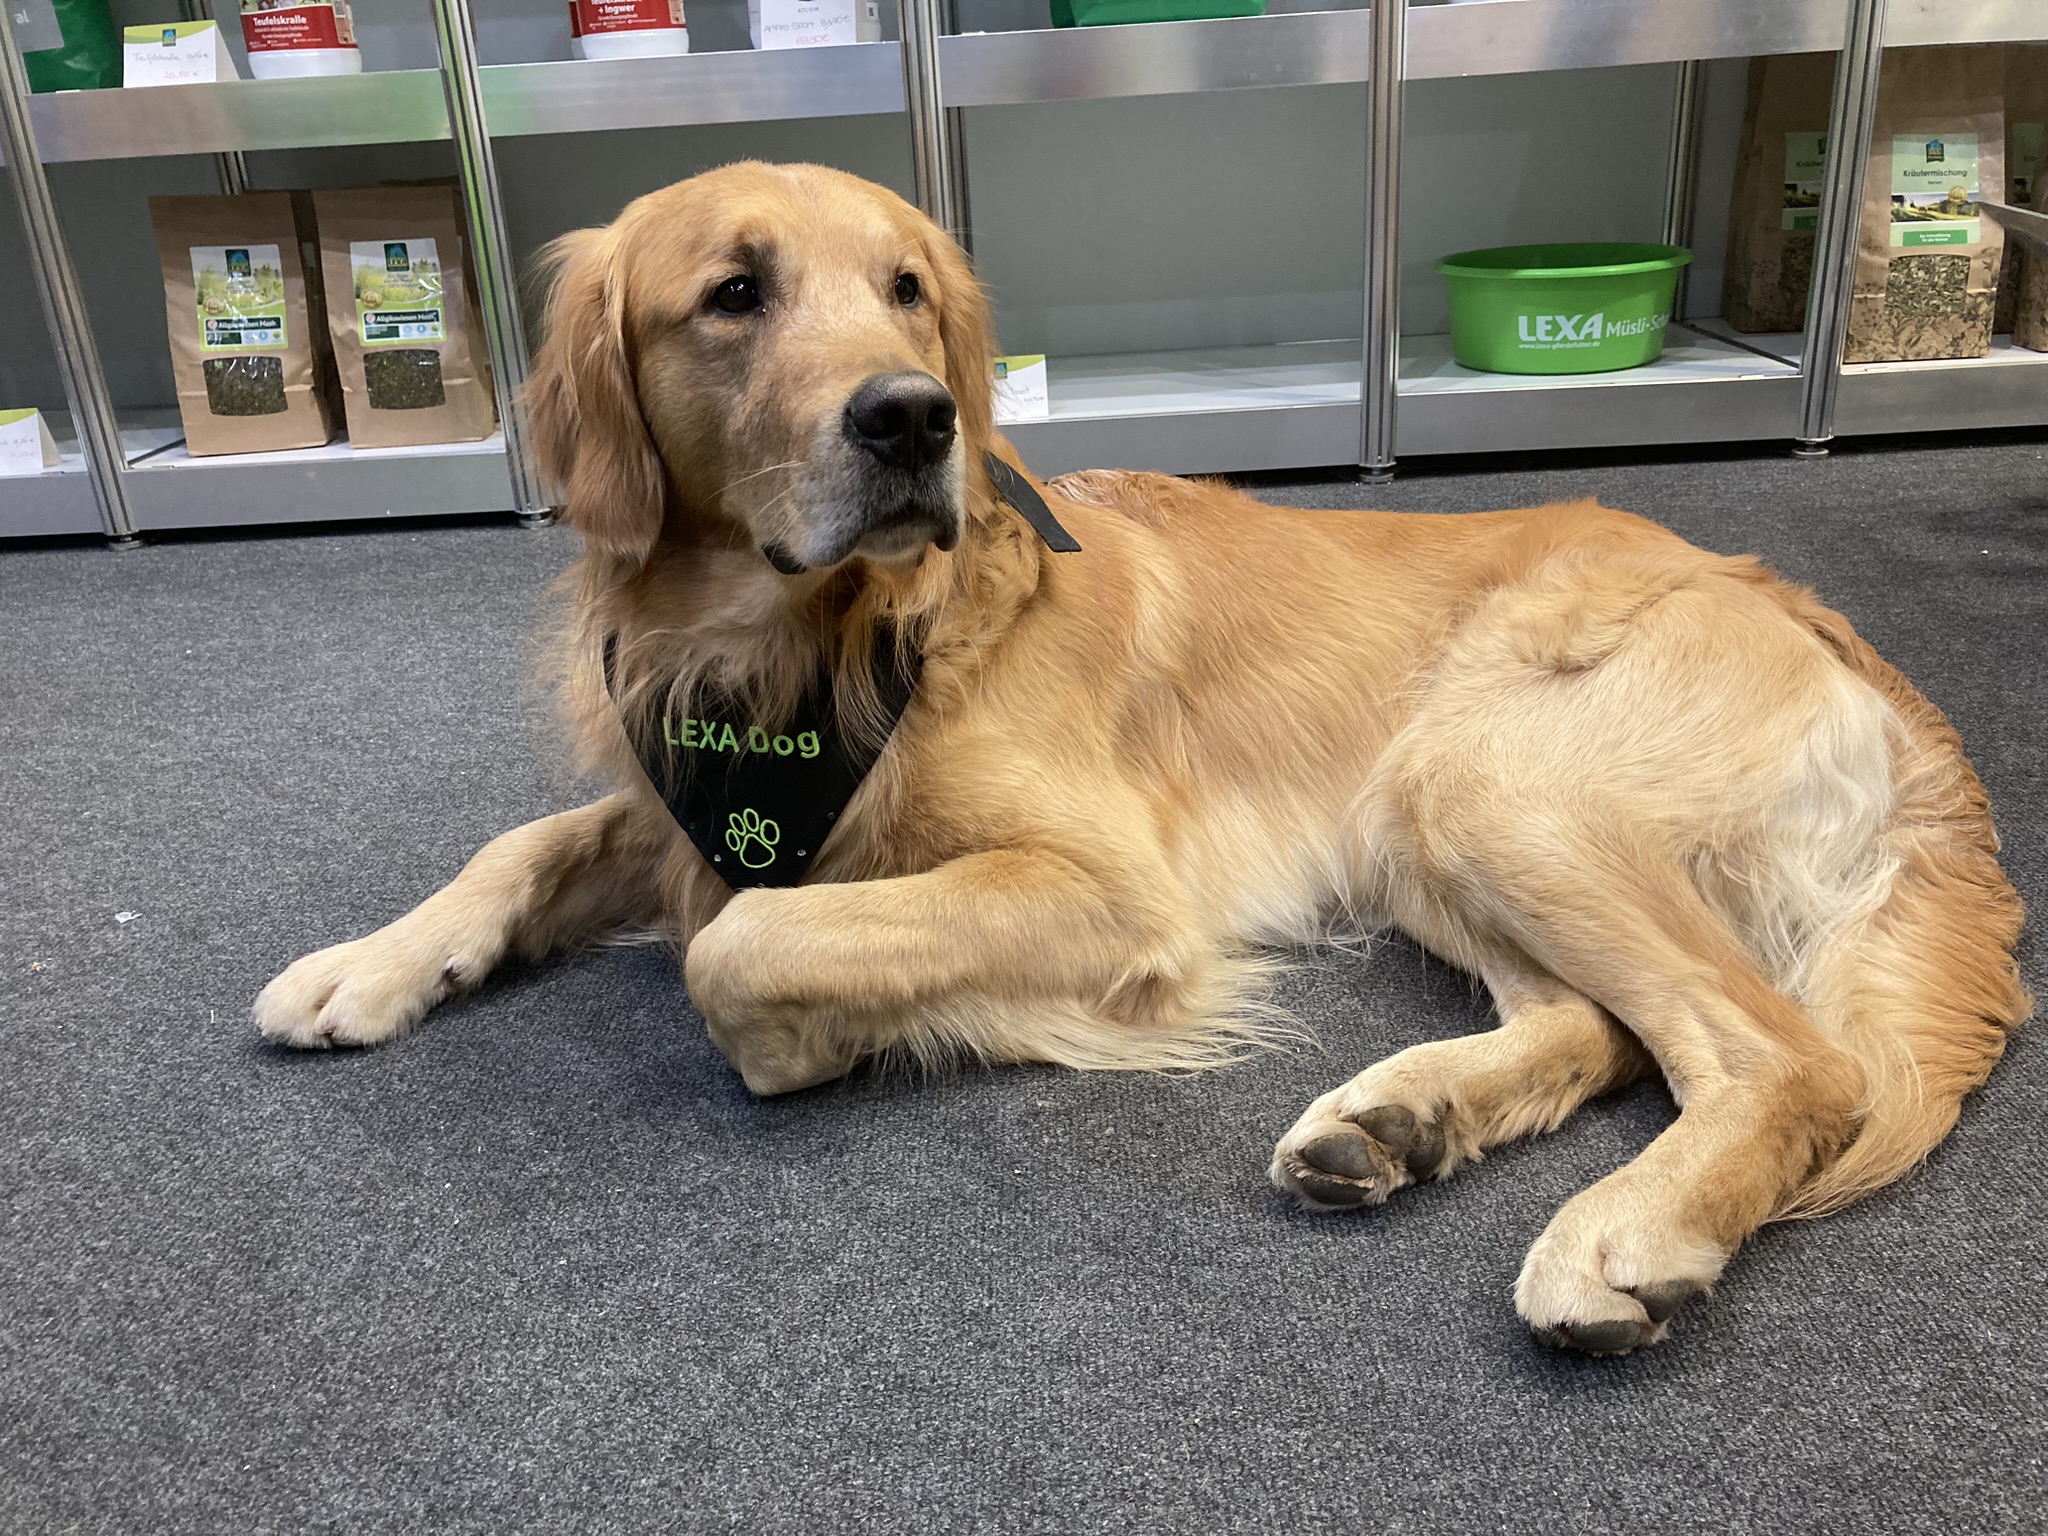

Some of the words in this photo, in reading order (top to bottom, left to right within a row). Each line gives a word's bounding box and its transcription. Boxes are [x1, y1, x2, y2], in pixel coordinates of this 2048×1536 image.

[604, 4, 636, 15] Ingwer
[253, 15, 307, 26] Teufelskralle
[1903, 168, 1968, 177] Kräutermischung
[1518, 313, 1604, 341] LEXA
[663, 716, 740, 753] LEXA
[749, 726, 820, 758] Dog
